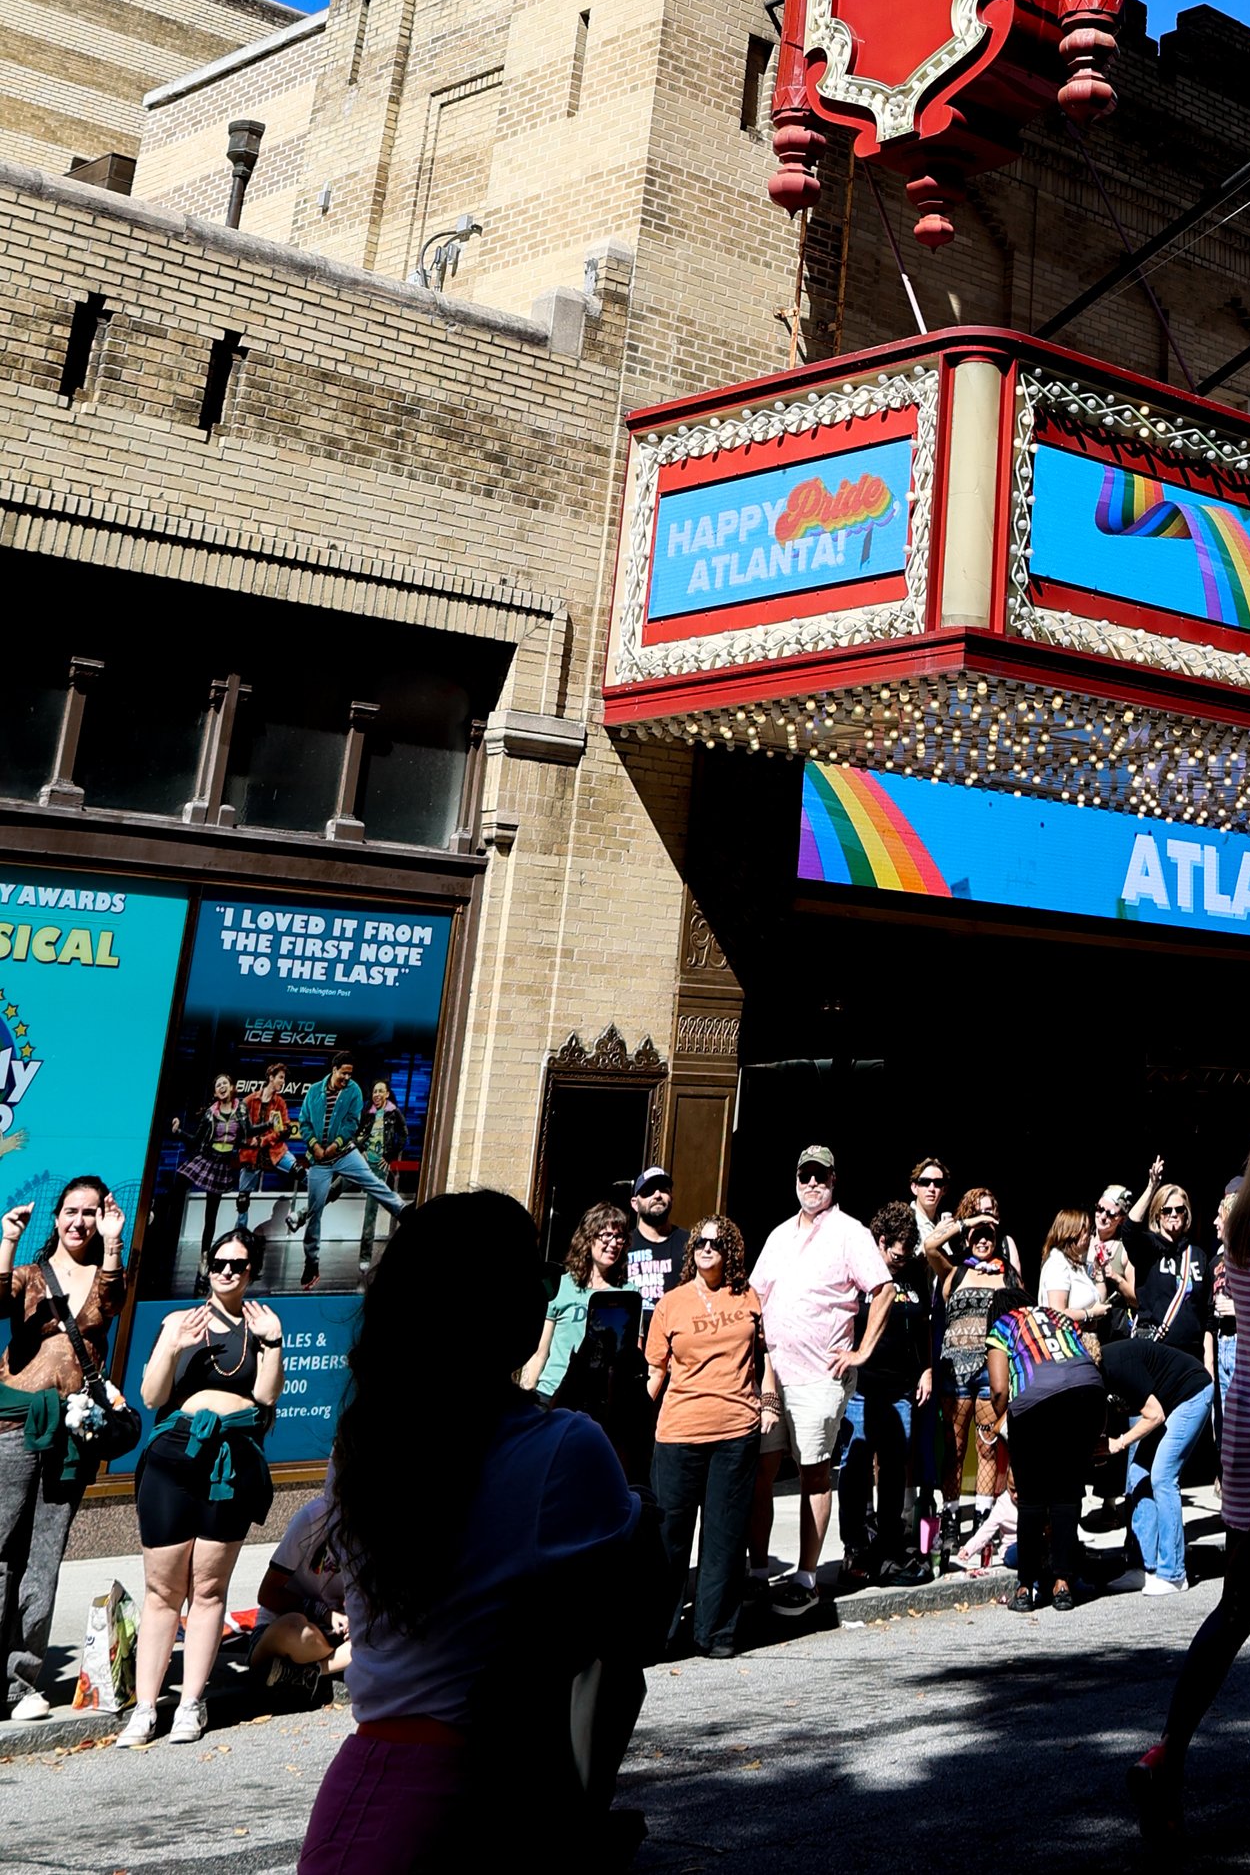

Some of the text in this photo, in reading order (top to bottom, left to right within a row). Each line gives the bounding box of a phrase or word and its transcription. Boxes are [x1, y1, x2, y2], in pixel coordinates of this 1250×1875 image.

[667, 498, 787, 557] HAPPY
[687, 529, 846, 595] ATLANTA!
[17, 885, 126, 913] AWARDS
[241, 909, 326, 935] LOVED
[332, 918, 358, 938] IT
[363, 921, 433, 945] FROM
[220, 930, 424, 966] THE FIRST NOTE
[238, 955, 271, 976] TO
[277, 958, 329, 981] THE
[286, 985, 352, 997] The Washington Post
[245, 1017, 316, 1032] LEARN TO
[244, 1030, 338, 1046] ICE SKATE
[627, 1248, 653, 1264] THIS
[627, 1258, 672, 1277] IS WHAT
[1159, 1256, 1203, 1281] LOE
[692, 1309, 745, 1336] Dyke
[316, 1332, 327, 1348] &
